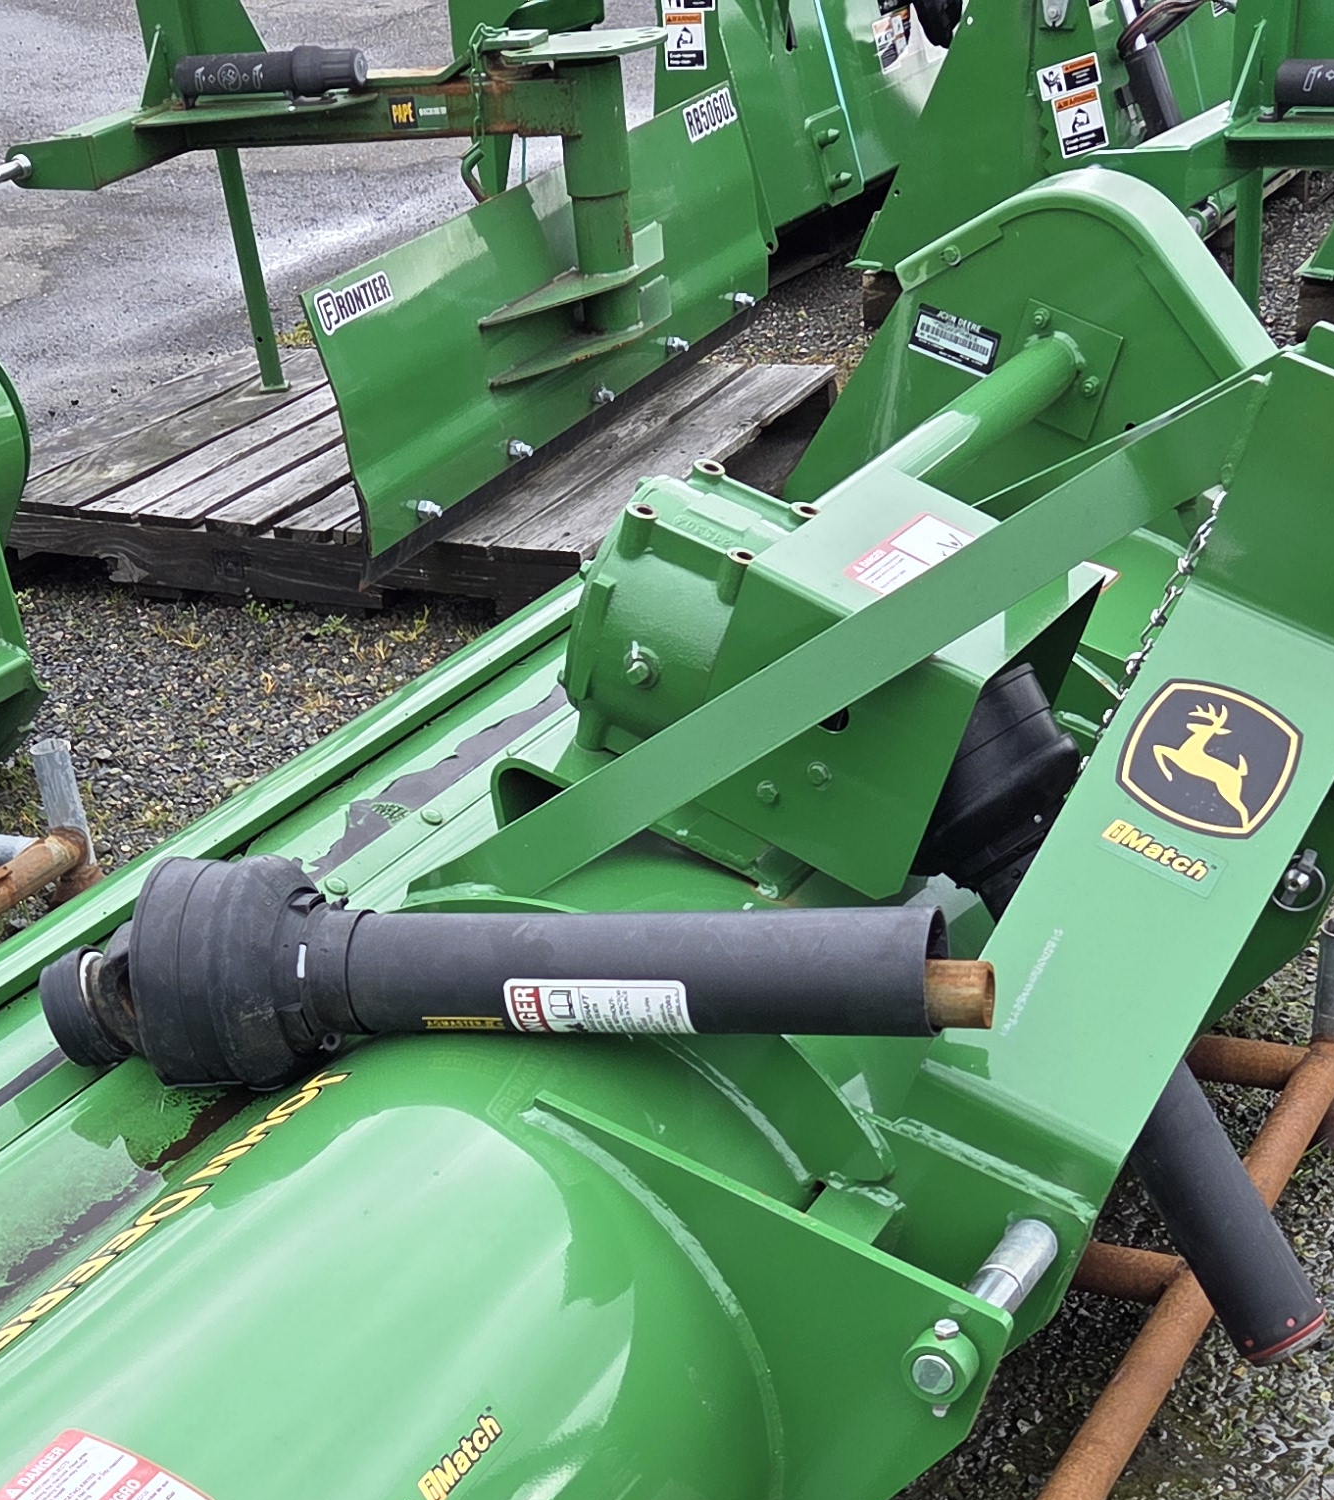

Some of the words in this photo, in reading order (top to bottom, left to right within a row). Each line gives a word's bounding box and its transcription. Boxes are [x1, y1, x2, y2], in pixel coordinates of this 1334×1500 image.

[316, 274, 392, 332] FRONTIER
[1100, 818, 1209, 882] iMatch
[513, 986, 547, 1032] NGER
[185, 1071, 352, 1183] JOHN
[18, 1445, 67, 1488] DANGER
